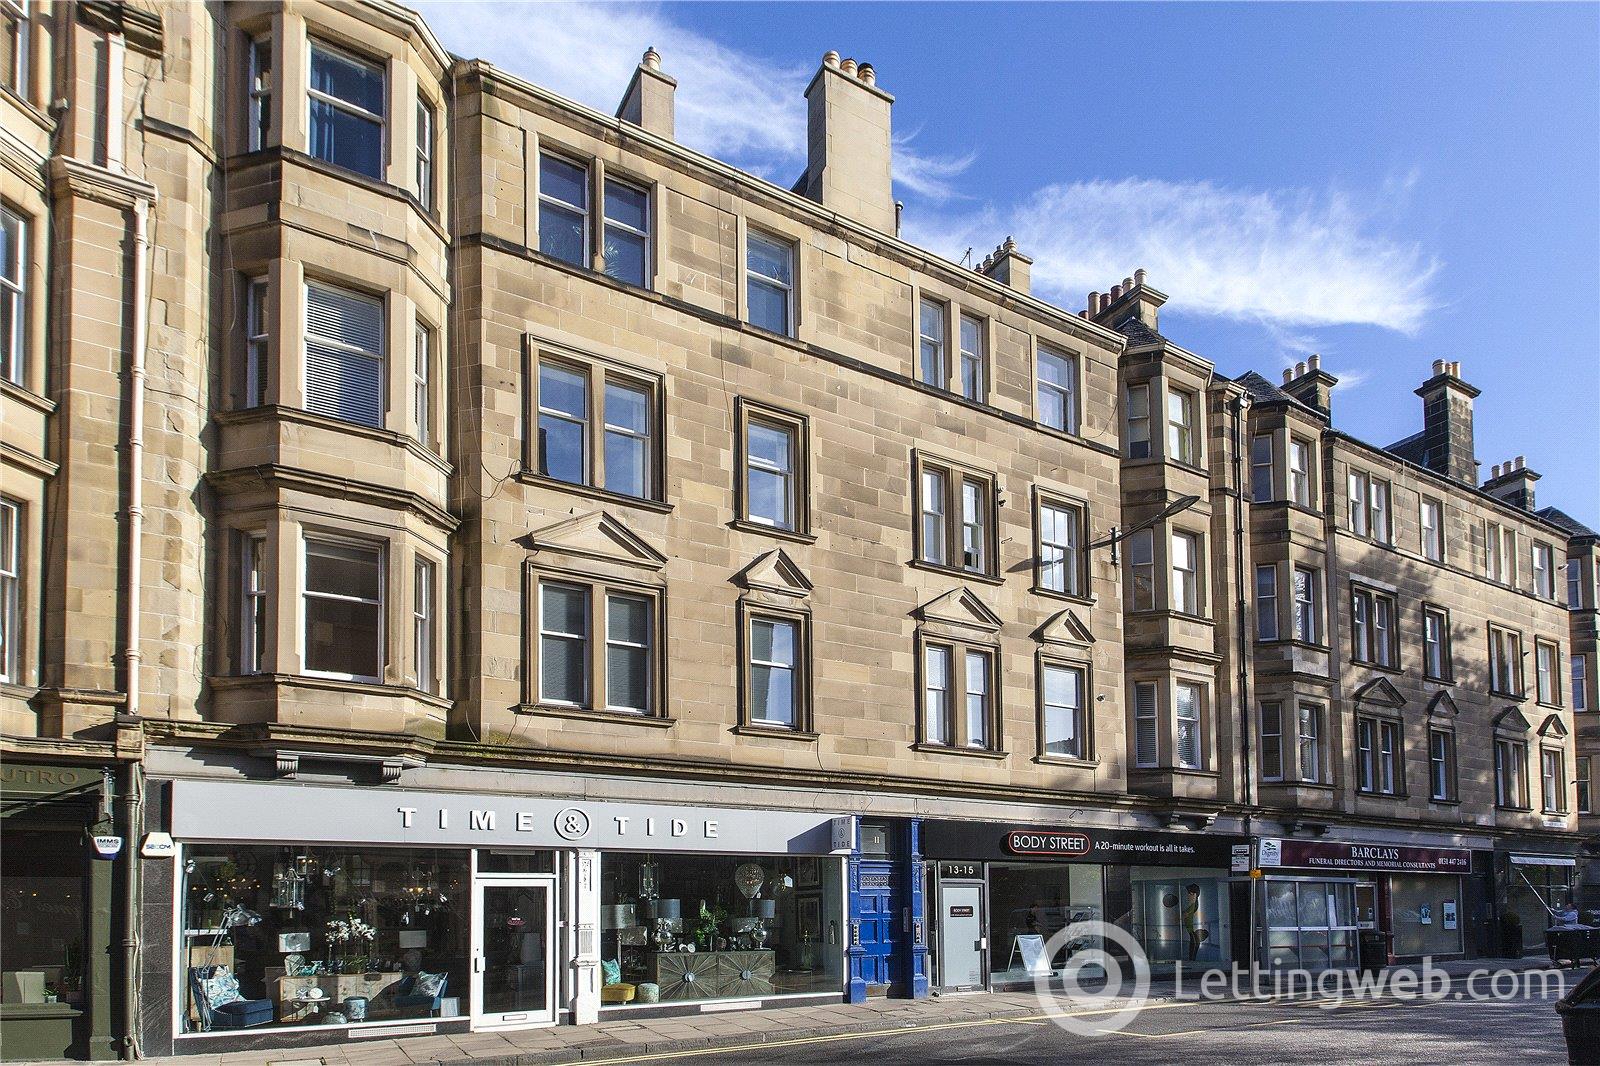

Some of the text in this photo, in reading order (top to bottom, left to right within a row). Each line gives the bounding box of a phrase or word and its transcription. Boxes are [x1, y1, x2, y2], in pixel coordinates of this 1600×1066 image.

[397, 807, 534, 832] TIME
[613, 816, 719, 839] TIDE
[1013, 835, 1085, 850] BODY STREET
[1094, 841, 1195, 853] A 20-minute workout is all it takes.
[1351, 846, 1399, 860] BARCLAYS
[1308, 857, 1333, 866] FUNERAL
[1334, 858, 1364, 866] DIRECTORS
[1376, 860, 1402, 868] MEMORIAL
[1402, 861, 1436, 869] CONSULTANTS
[948, 865, 974, 875] 13-15
